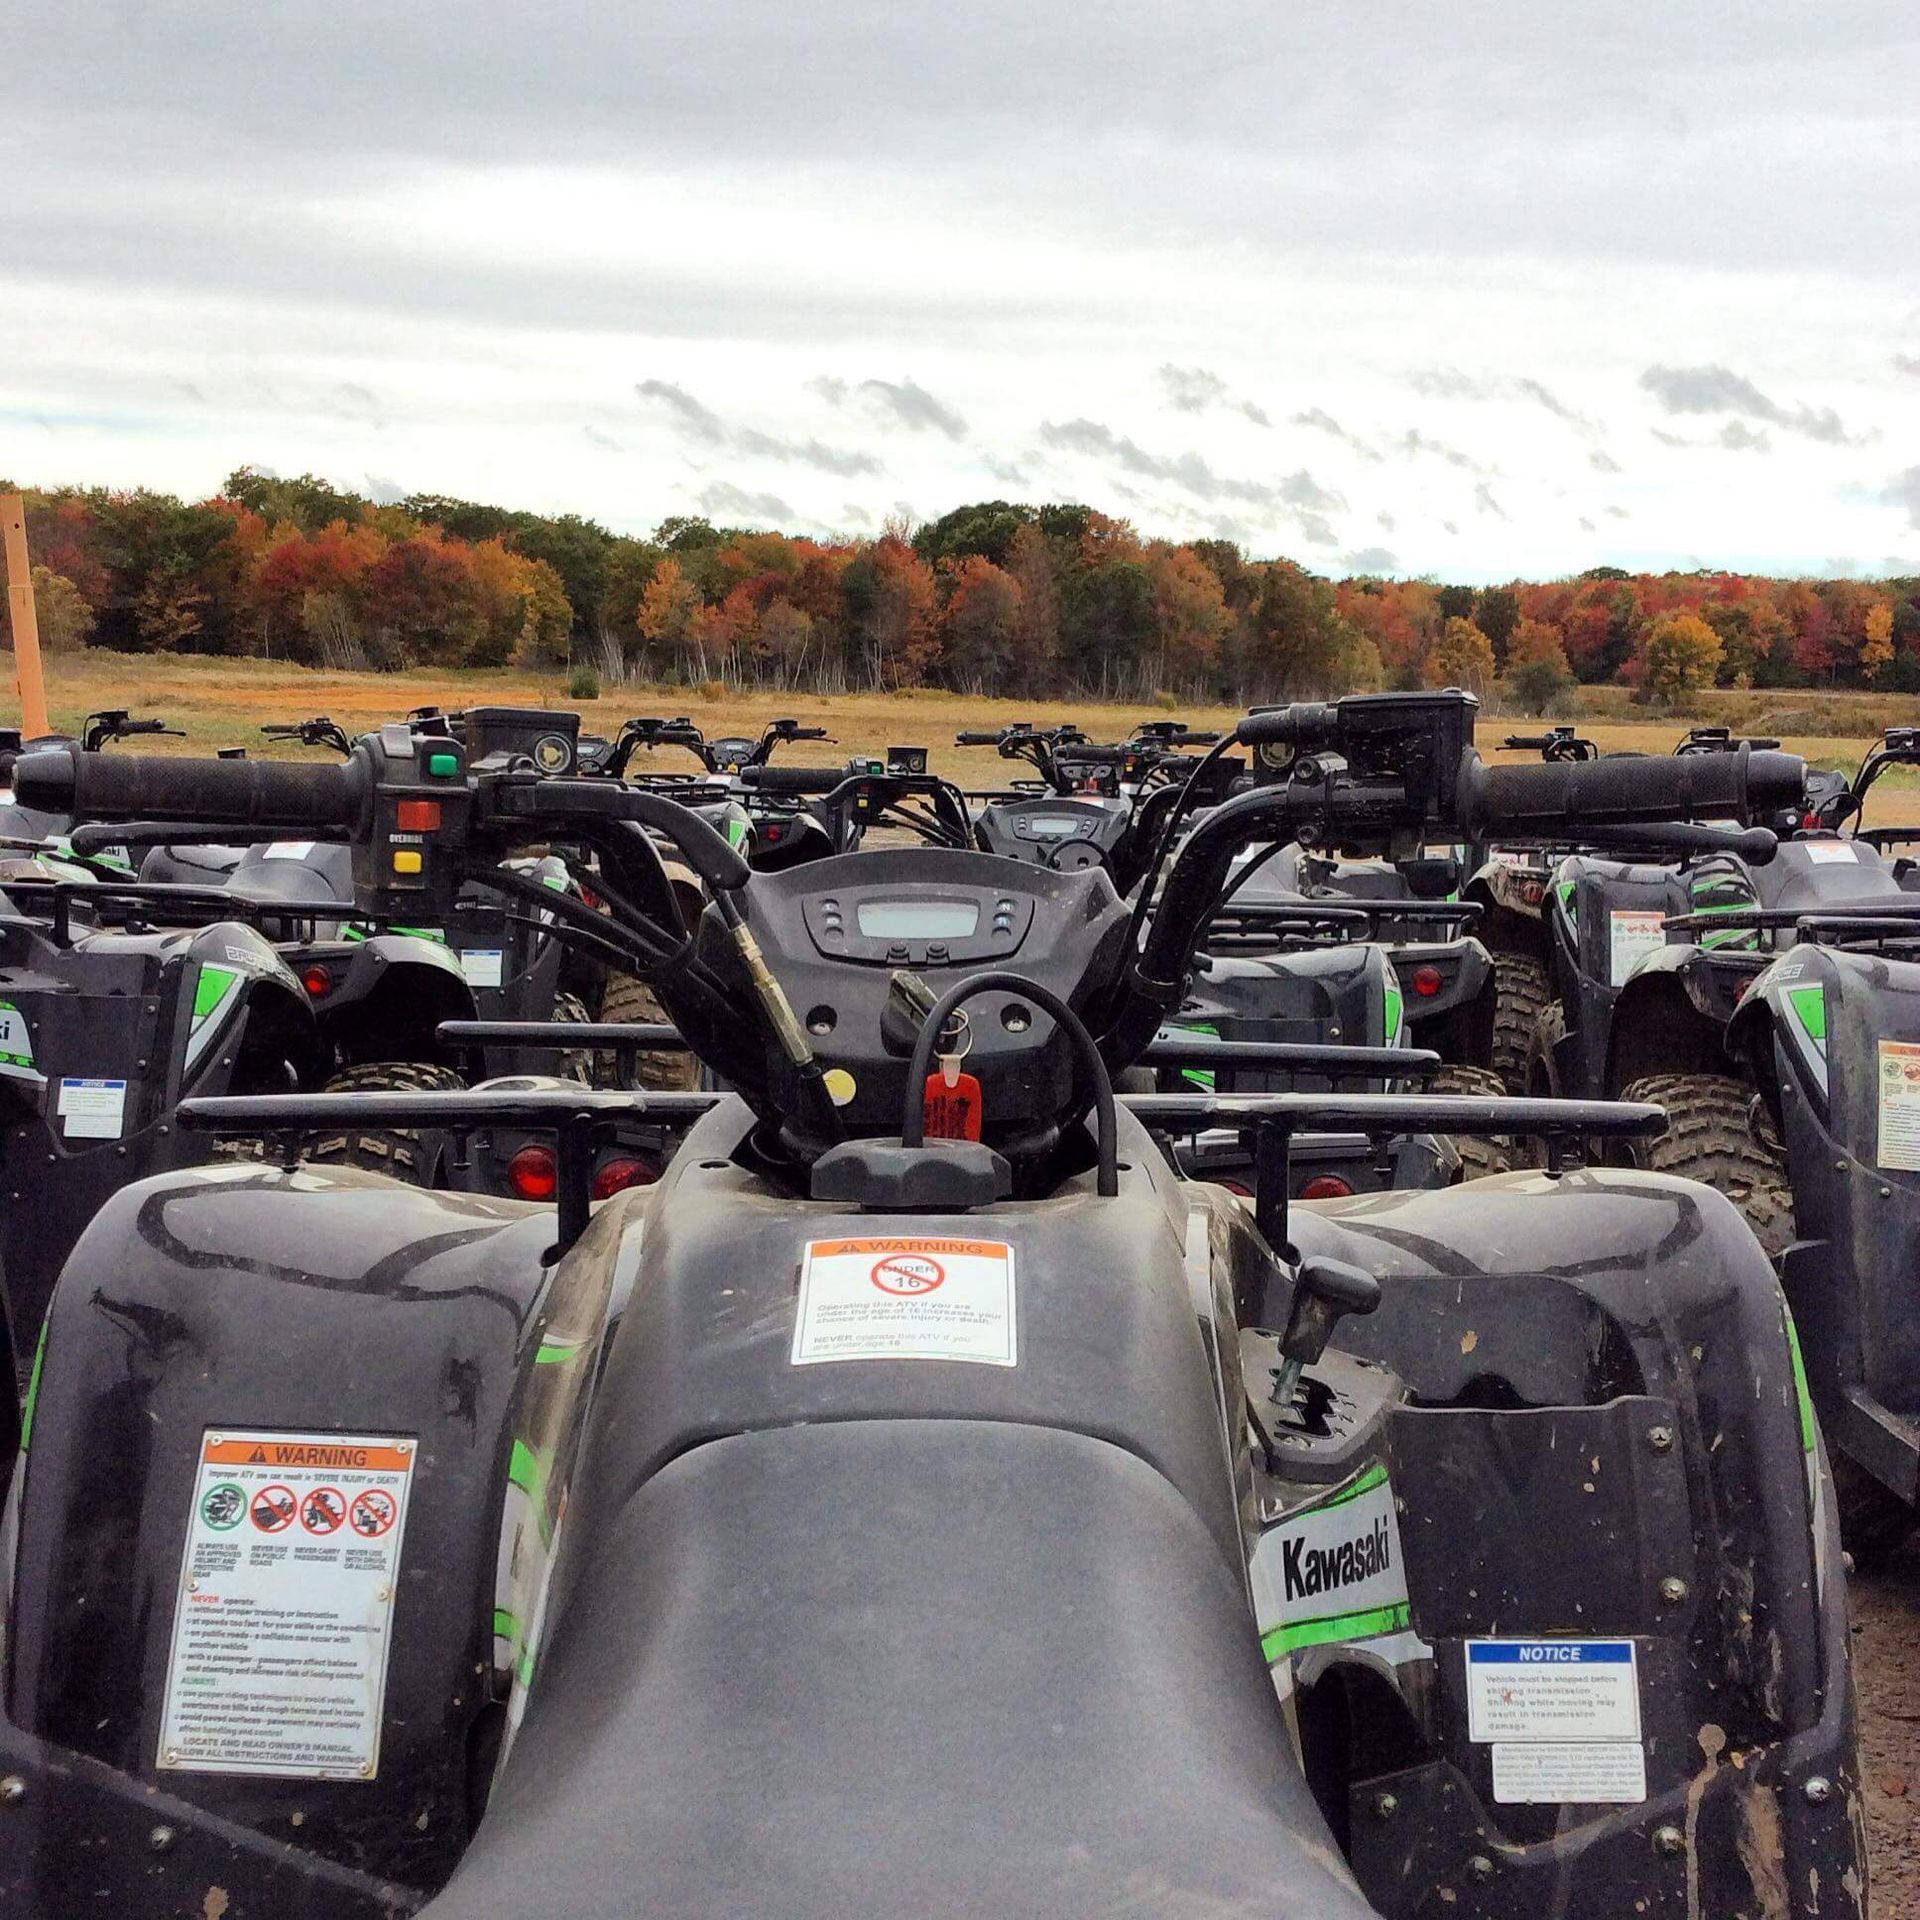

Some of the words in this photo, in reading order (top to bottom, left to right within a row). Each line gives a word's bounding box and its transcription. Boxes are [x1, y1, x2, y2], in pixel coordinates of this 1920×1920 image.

[868, 1241, 984, 1254] WARNING
[882, 1265, 935, 1273] UNDER
[894, 1276, 920, 1288] 16
[276, 1446, 368, 1467] WARNING
[1282, 1514, 1390, 1603] Kawasaki
[192, 1595, 220, 1604] NEVER
[1518, 1646, 1582, 1661] NOTICE
[1485, 1675, 1517, 1683] Vehicle
[1517, 1675, 1540, 1683] must
[1541, 1675, 1552, 1683] be
[1553, 1675, 1589, 1685] stopped
[1590, 1675, 1618, 1683] before
[1486, 1699, 1526, 1708] Shifting
[1529, 1699, 1555, 1707] while
[1557, 1699, 1594, 1708] moving
[1596, 1699, 1617, 1708] may
[1486, 1710, 1517, 1719] result
[1519, 1710, 1530, 1718] in
[1531, 1710, 1597, 1719] transmission
